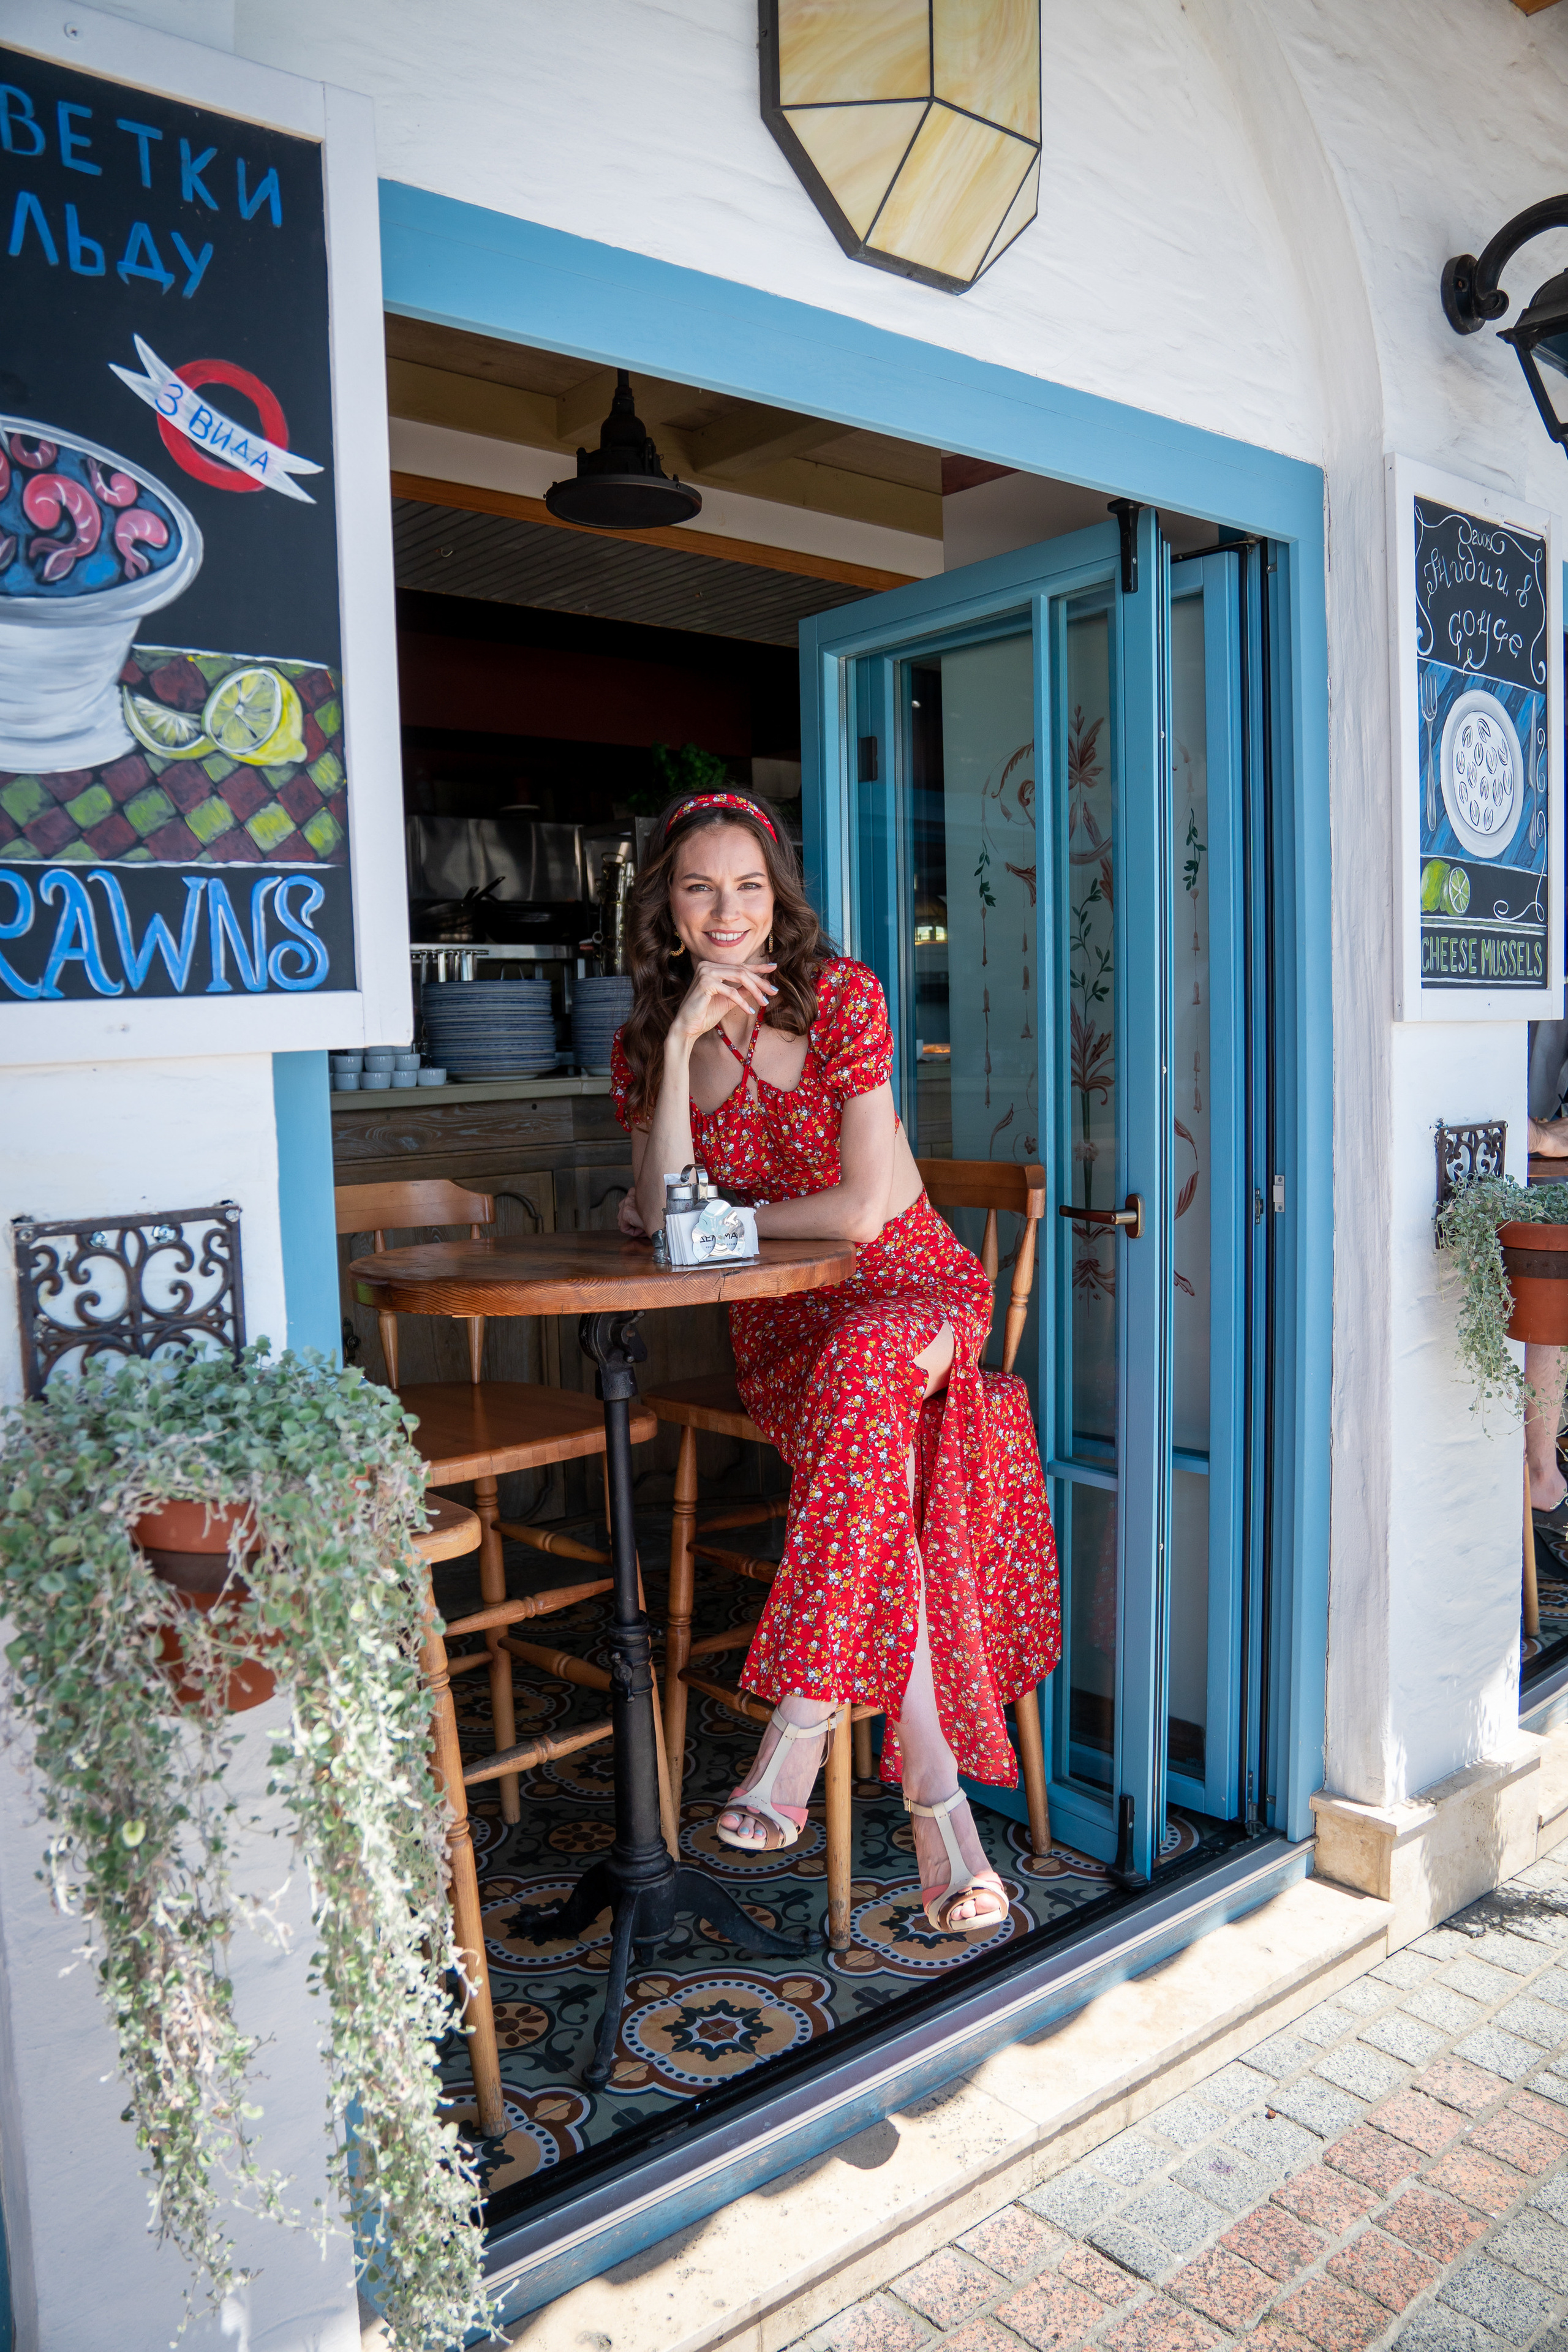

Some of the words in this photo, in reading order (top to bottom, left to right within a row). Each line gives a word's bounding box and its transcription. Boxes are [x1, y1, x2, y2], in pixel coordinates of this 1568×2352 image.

[0, 83, 282, 228] ВЕТКИ
[9, 190, 214, 299] ЛЬДУ
[188, 404, 268, 475] ВИДА
[1421, 936, 1477, 974] CHEESE
[1481, 938, 1543, 977] MUSSELS
